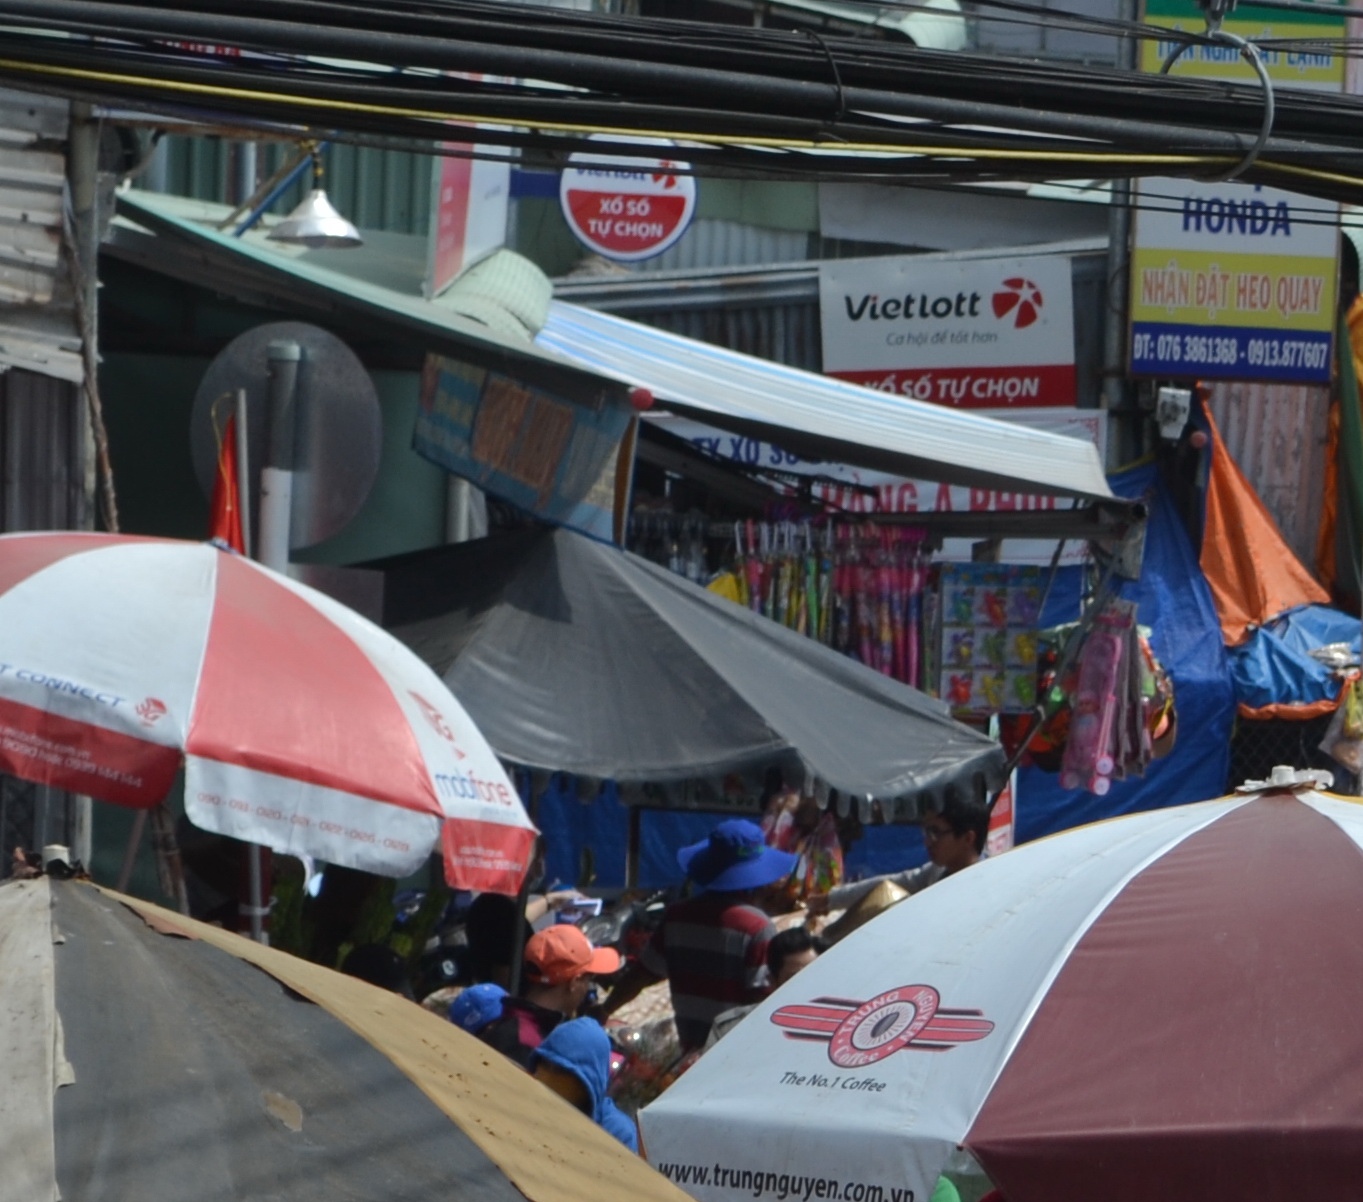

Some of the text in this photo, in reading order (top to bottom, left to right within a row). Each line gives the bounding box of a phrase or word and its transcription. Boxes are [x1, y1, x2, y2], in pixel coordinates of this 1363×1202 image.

[626, 196, 650, 217] SỐ
[1181, 197, 1292, 237] HONDA
[588, 218, 664, 241] TỰ CHỌN
[845, 291, 981, 322] Vietlott
[1236, 273, 1271, 311] HEO
[1276, 275, 1324, 319] QUAY
[1157, 334, 1181, 361] 076
[901, 373, 933, 400] SỐ
[936, 376, 971, 403] TỰ
[972, 377, 1039, 403] CHỌN
[15, 669, 126, 708] CONNECT
[838, 990, 901, 1036] TRUNG
[899, 989, 935, 1043] NGUYEN
[833, 1046, 880, 1066] Coffee
[779, 1071, 807, 1087] The
[841, 1076, 888, 1093] Coffee
